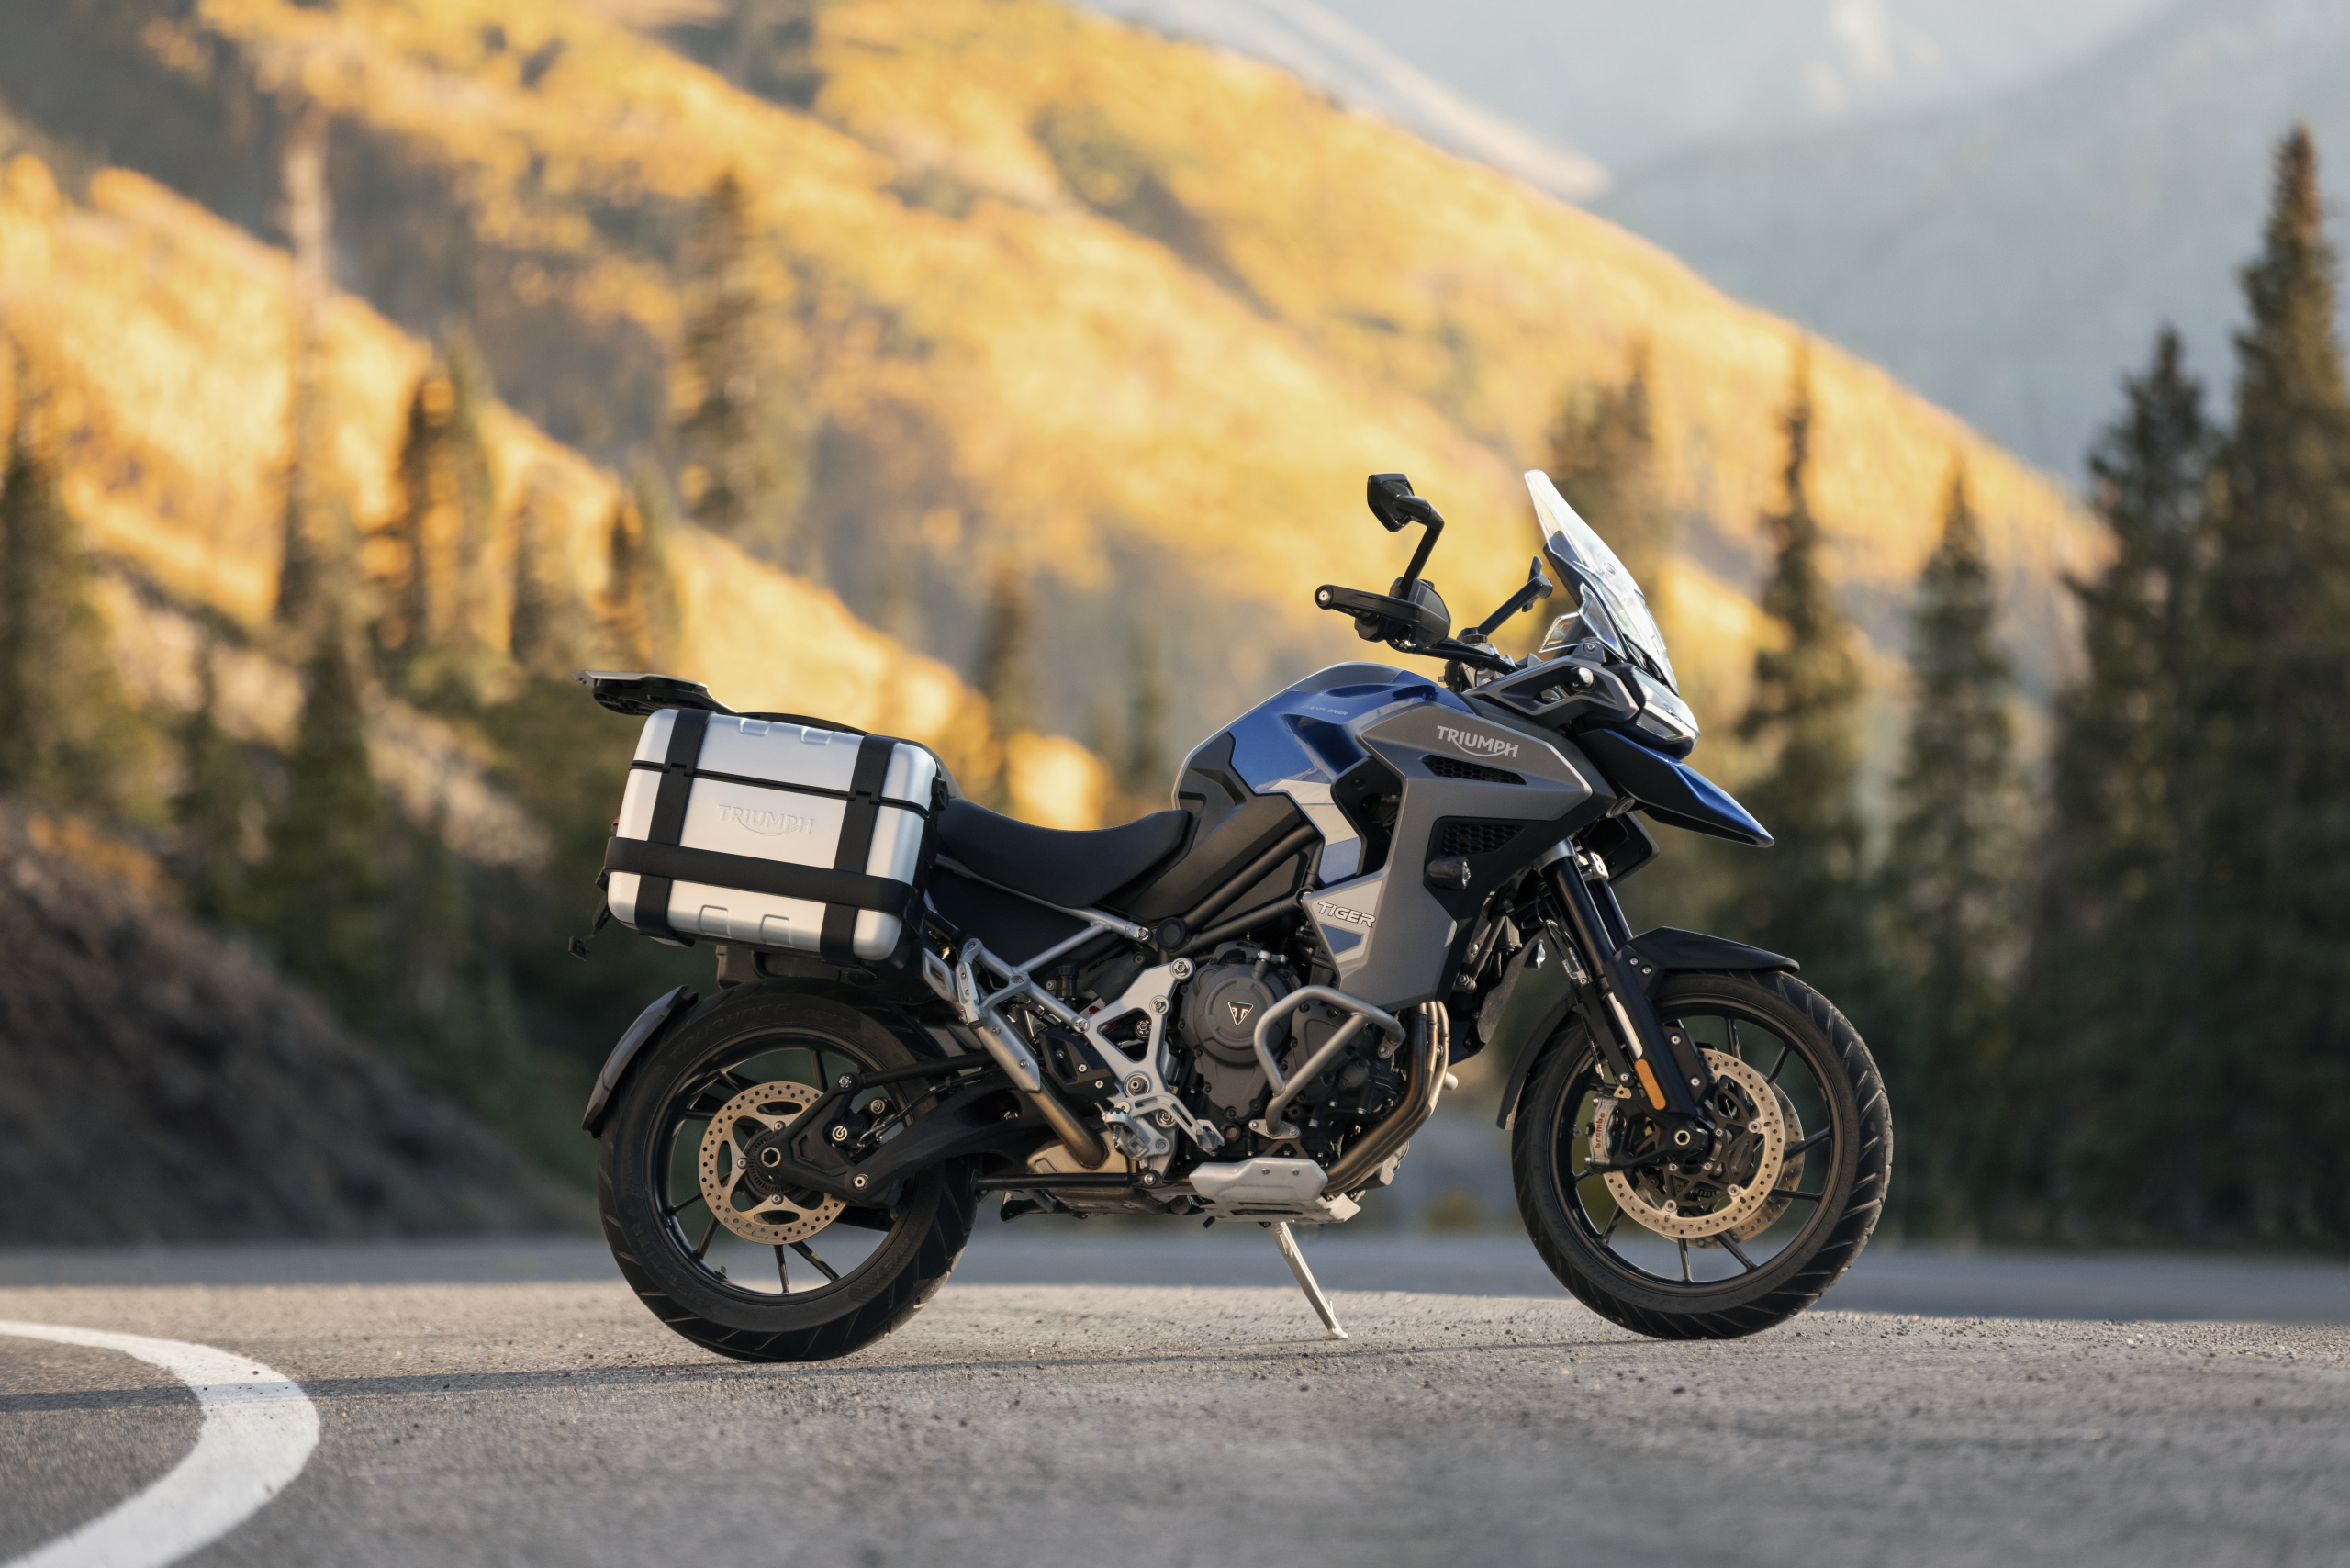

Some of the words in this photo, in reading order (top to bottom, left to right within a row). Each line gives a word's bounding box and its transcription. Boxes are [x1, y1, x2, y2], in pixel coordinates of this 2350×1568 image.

[1437, 725, 1519, 758] TRIUMPH
[718, 804, 813, 836] TRIUMPH
[1317, 901, 1376, 928] TIGER
[1595, 1112, 1606, 1148] brembo
